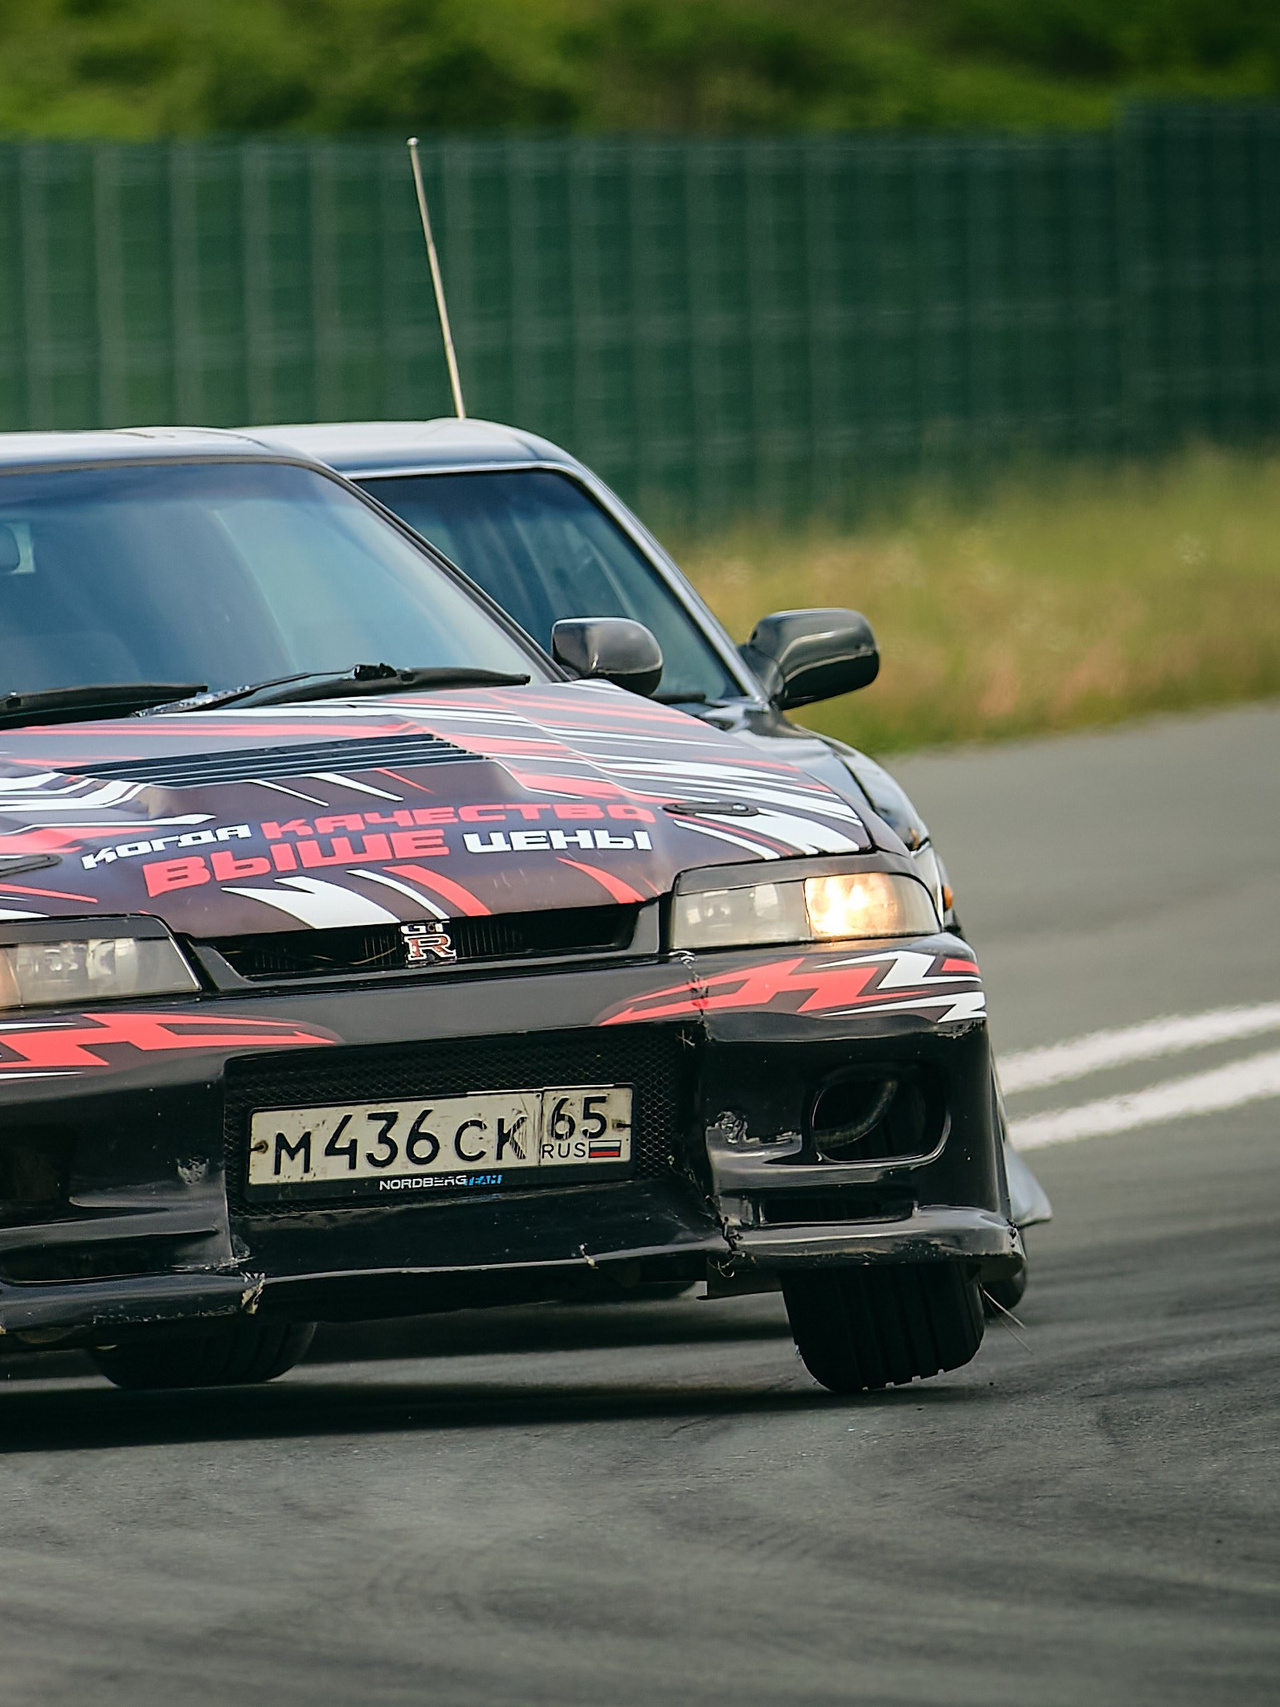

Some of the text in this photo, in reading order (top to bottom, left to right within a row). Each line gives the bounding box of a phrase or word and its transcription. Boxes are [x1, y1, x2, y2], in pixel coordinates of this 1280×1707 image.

[260, 804, 656, 841] КАЧЕСТВО
[142, 828, 653, 898] ВЫШЕ ЦЕНЫ
[550, 1095, 609, 1140] 65
[541, 1144, 586, 1160] RUS
